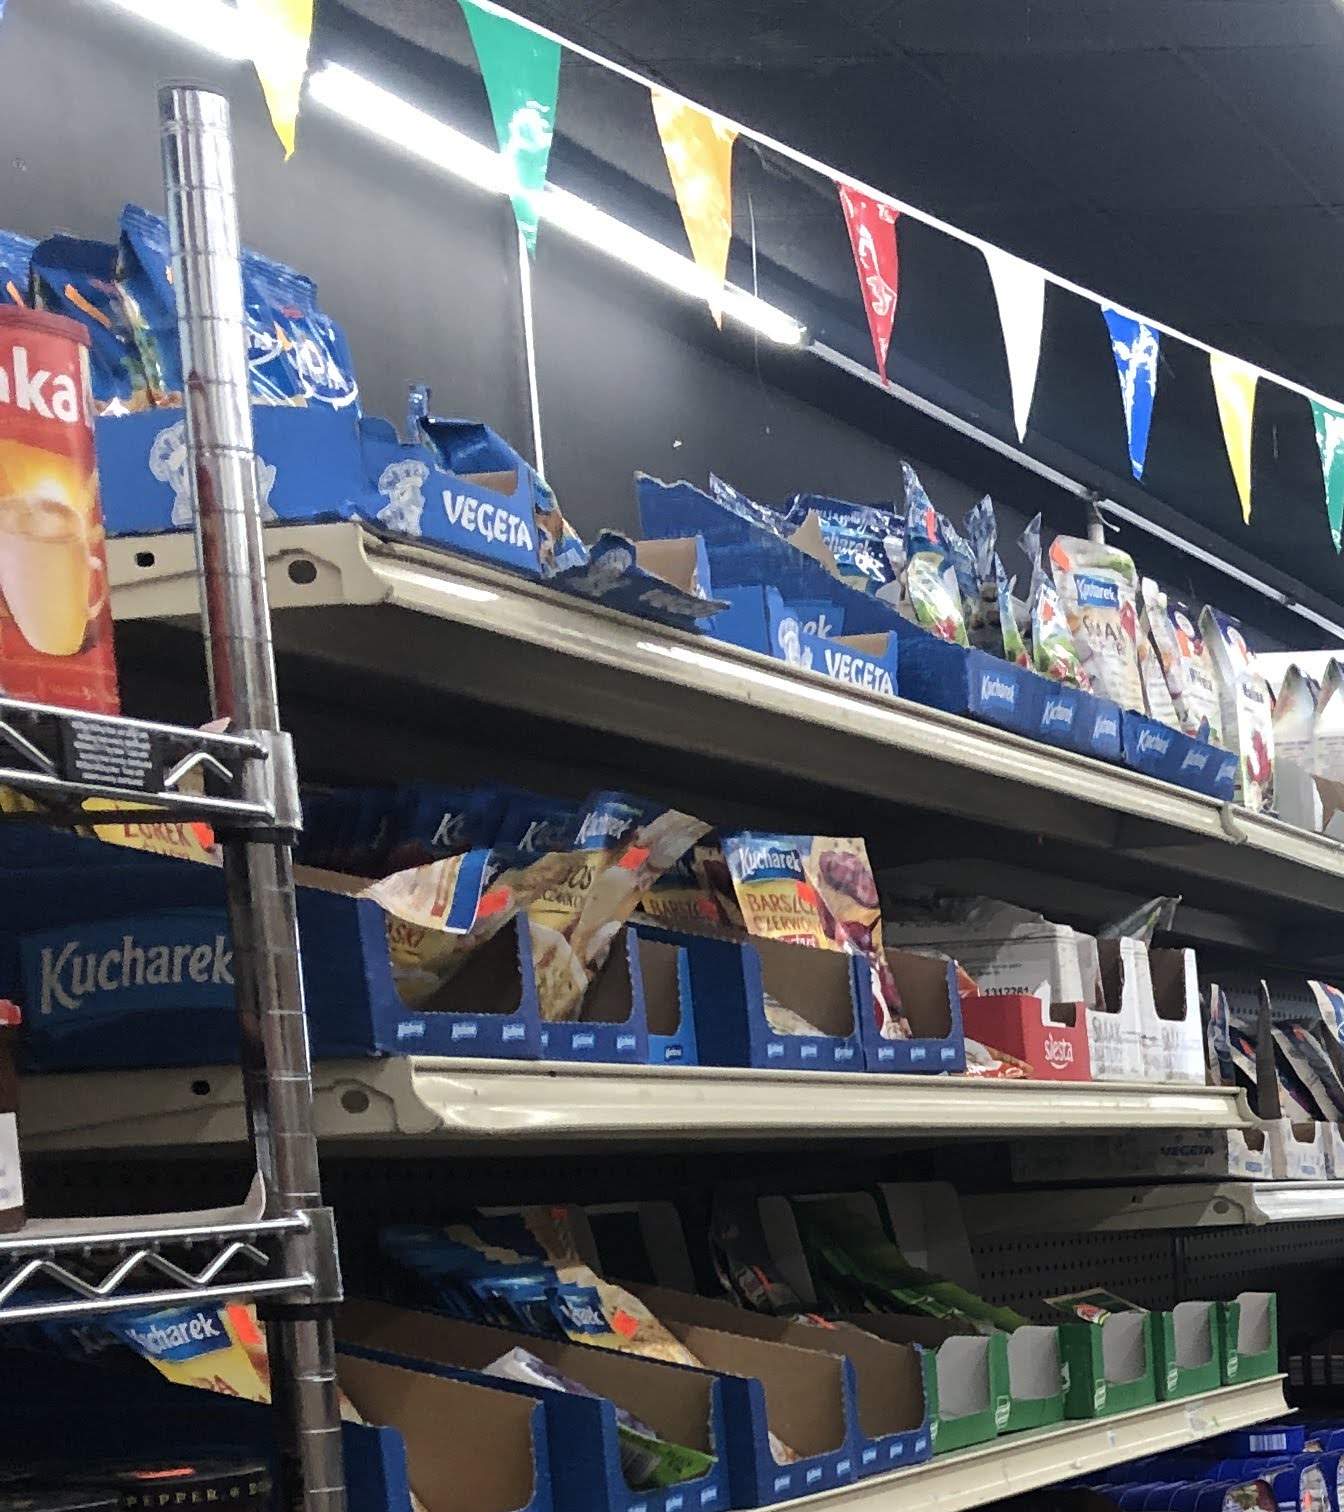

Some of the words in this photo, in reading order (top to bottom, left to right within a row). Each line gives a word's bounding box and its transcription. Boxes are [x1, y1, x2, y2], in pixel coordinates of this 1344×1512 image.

[442, 490, 533, 552] VEGETA
[825, 649, 895, 697] VEGETA
[739, 846, 801, 876] Kucharek
[40, 935, 234, 1015] Kucharek
[1044, 1032, 1074, 1063] siesta
